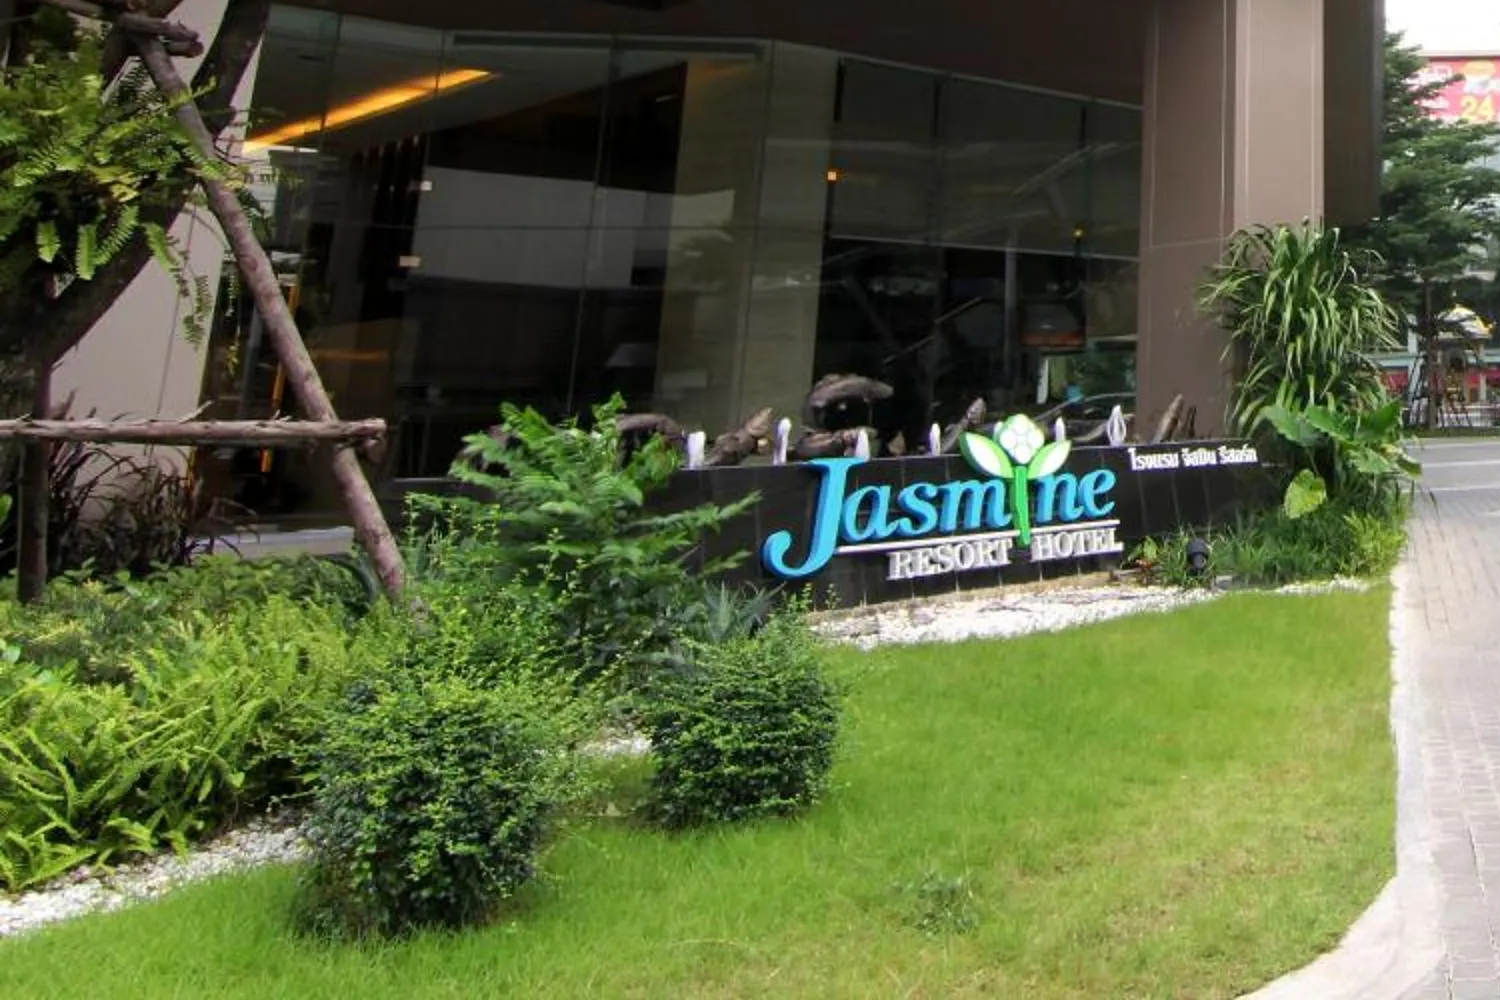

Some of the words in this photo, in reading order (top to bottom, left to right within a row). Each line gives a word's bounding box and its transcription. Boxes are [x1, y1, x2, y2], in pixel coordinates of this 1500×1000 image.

[762, 416, 1117, 580] Jasmine
[886, 538, 1014, 581] RESORT
[1030, 527, 1124, 562] HOTEL
